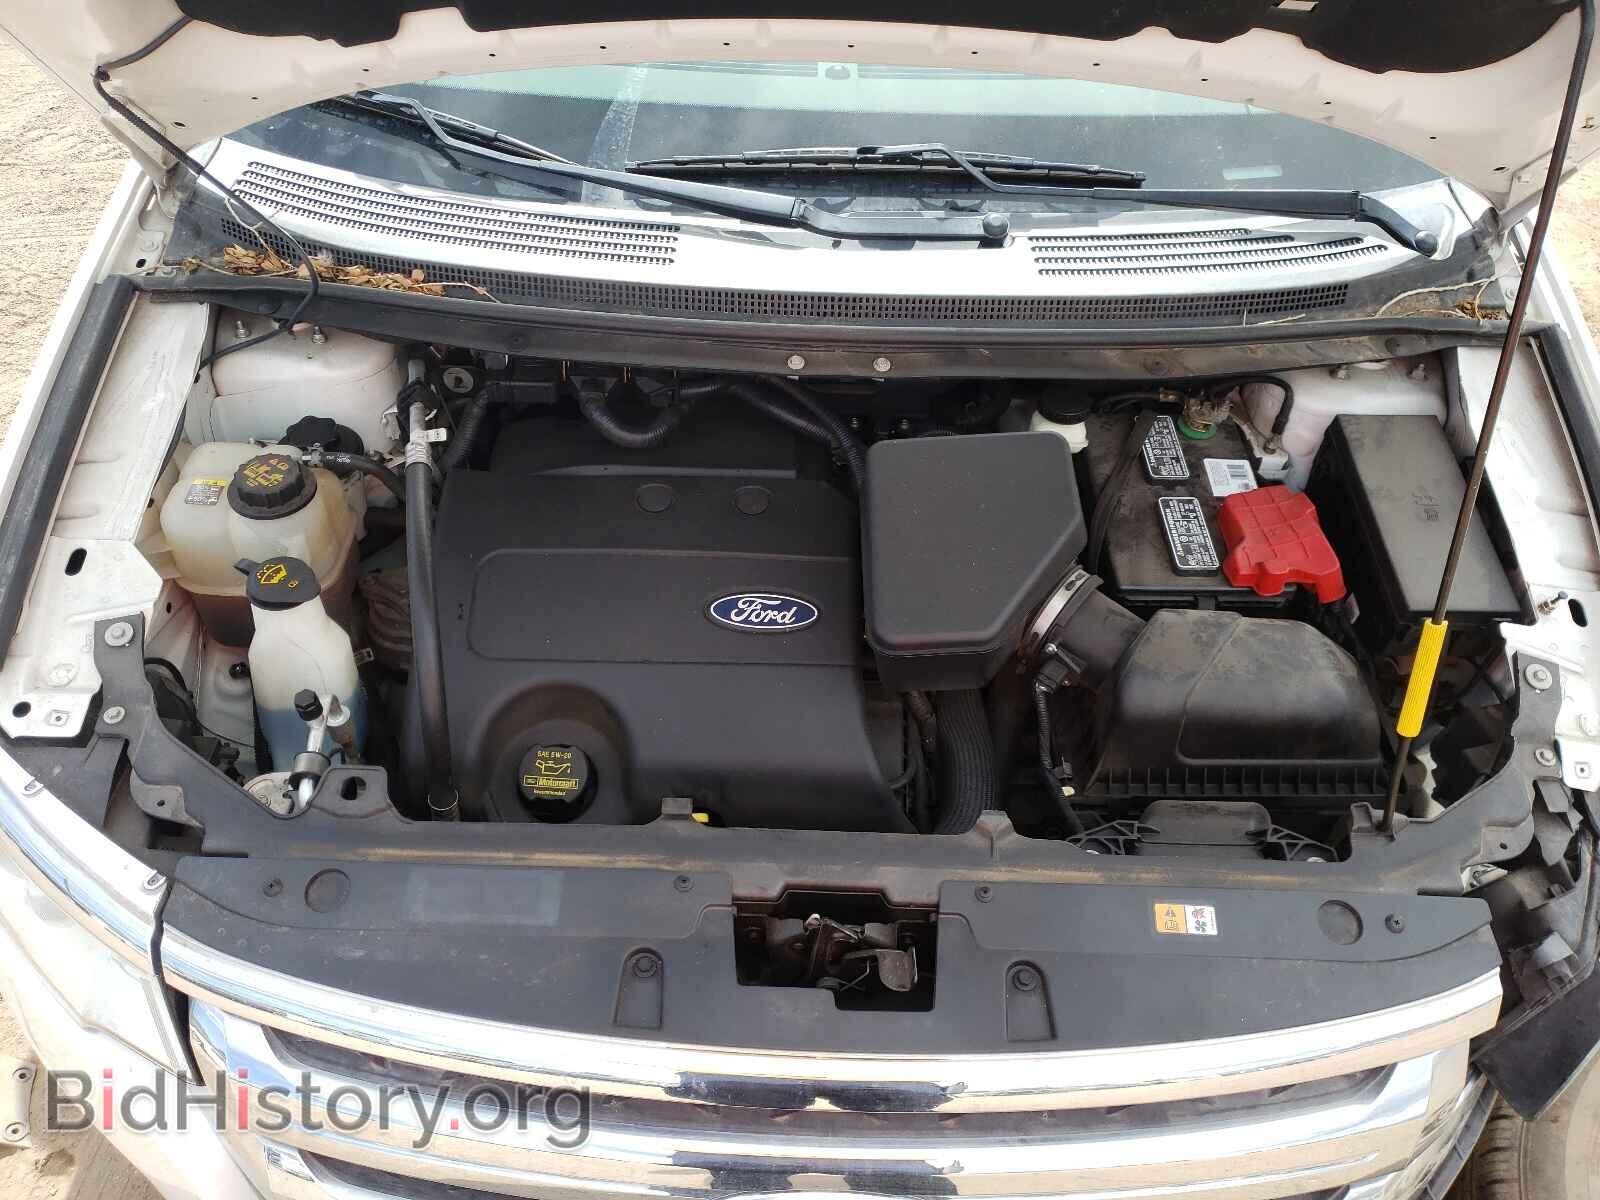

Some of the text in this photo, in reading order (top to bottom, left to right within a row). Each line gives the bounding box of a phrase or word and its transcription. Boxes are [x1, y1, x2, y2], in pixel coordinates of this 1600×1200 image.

[730, 597, 797, 624] Ford
[537, 750, 550, 758] SAE
[539, 779, 576, 788] Motorcraft
